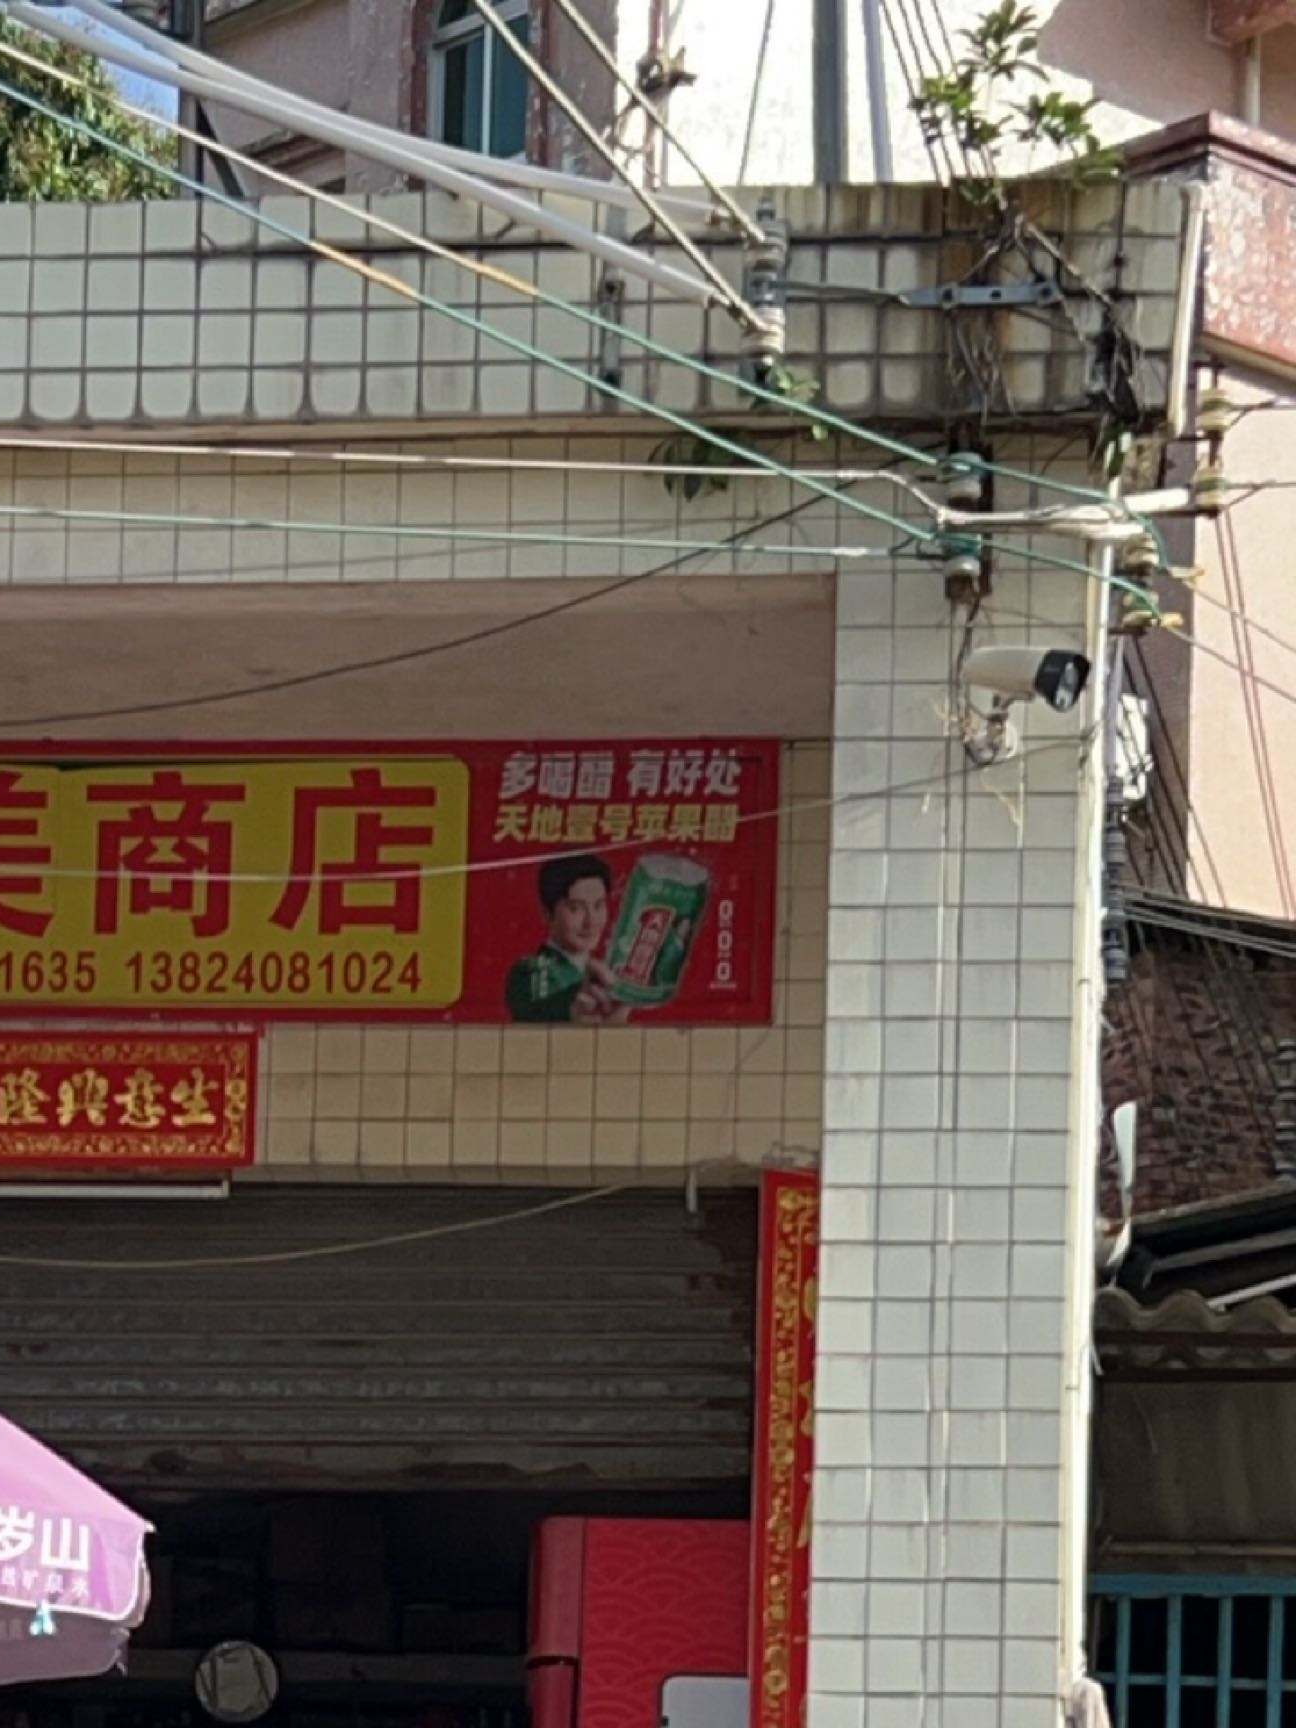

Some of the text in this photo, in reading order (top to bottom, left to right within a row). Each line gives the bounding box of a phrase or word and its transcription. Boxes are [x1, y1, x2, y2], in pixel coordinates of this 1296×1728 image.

[627, 749, 741, 797] 有好处
[493, 803, 738, 842] 天地壹号苹果醋
[126, 950, 423, 995] 13824081024
